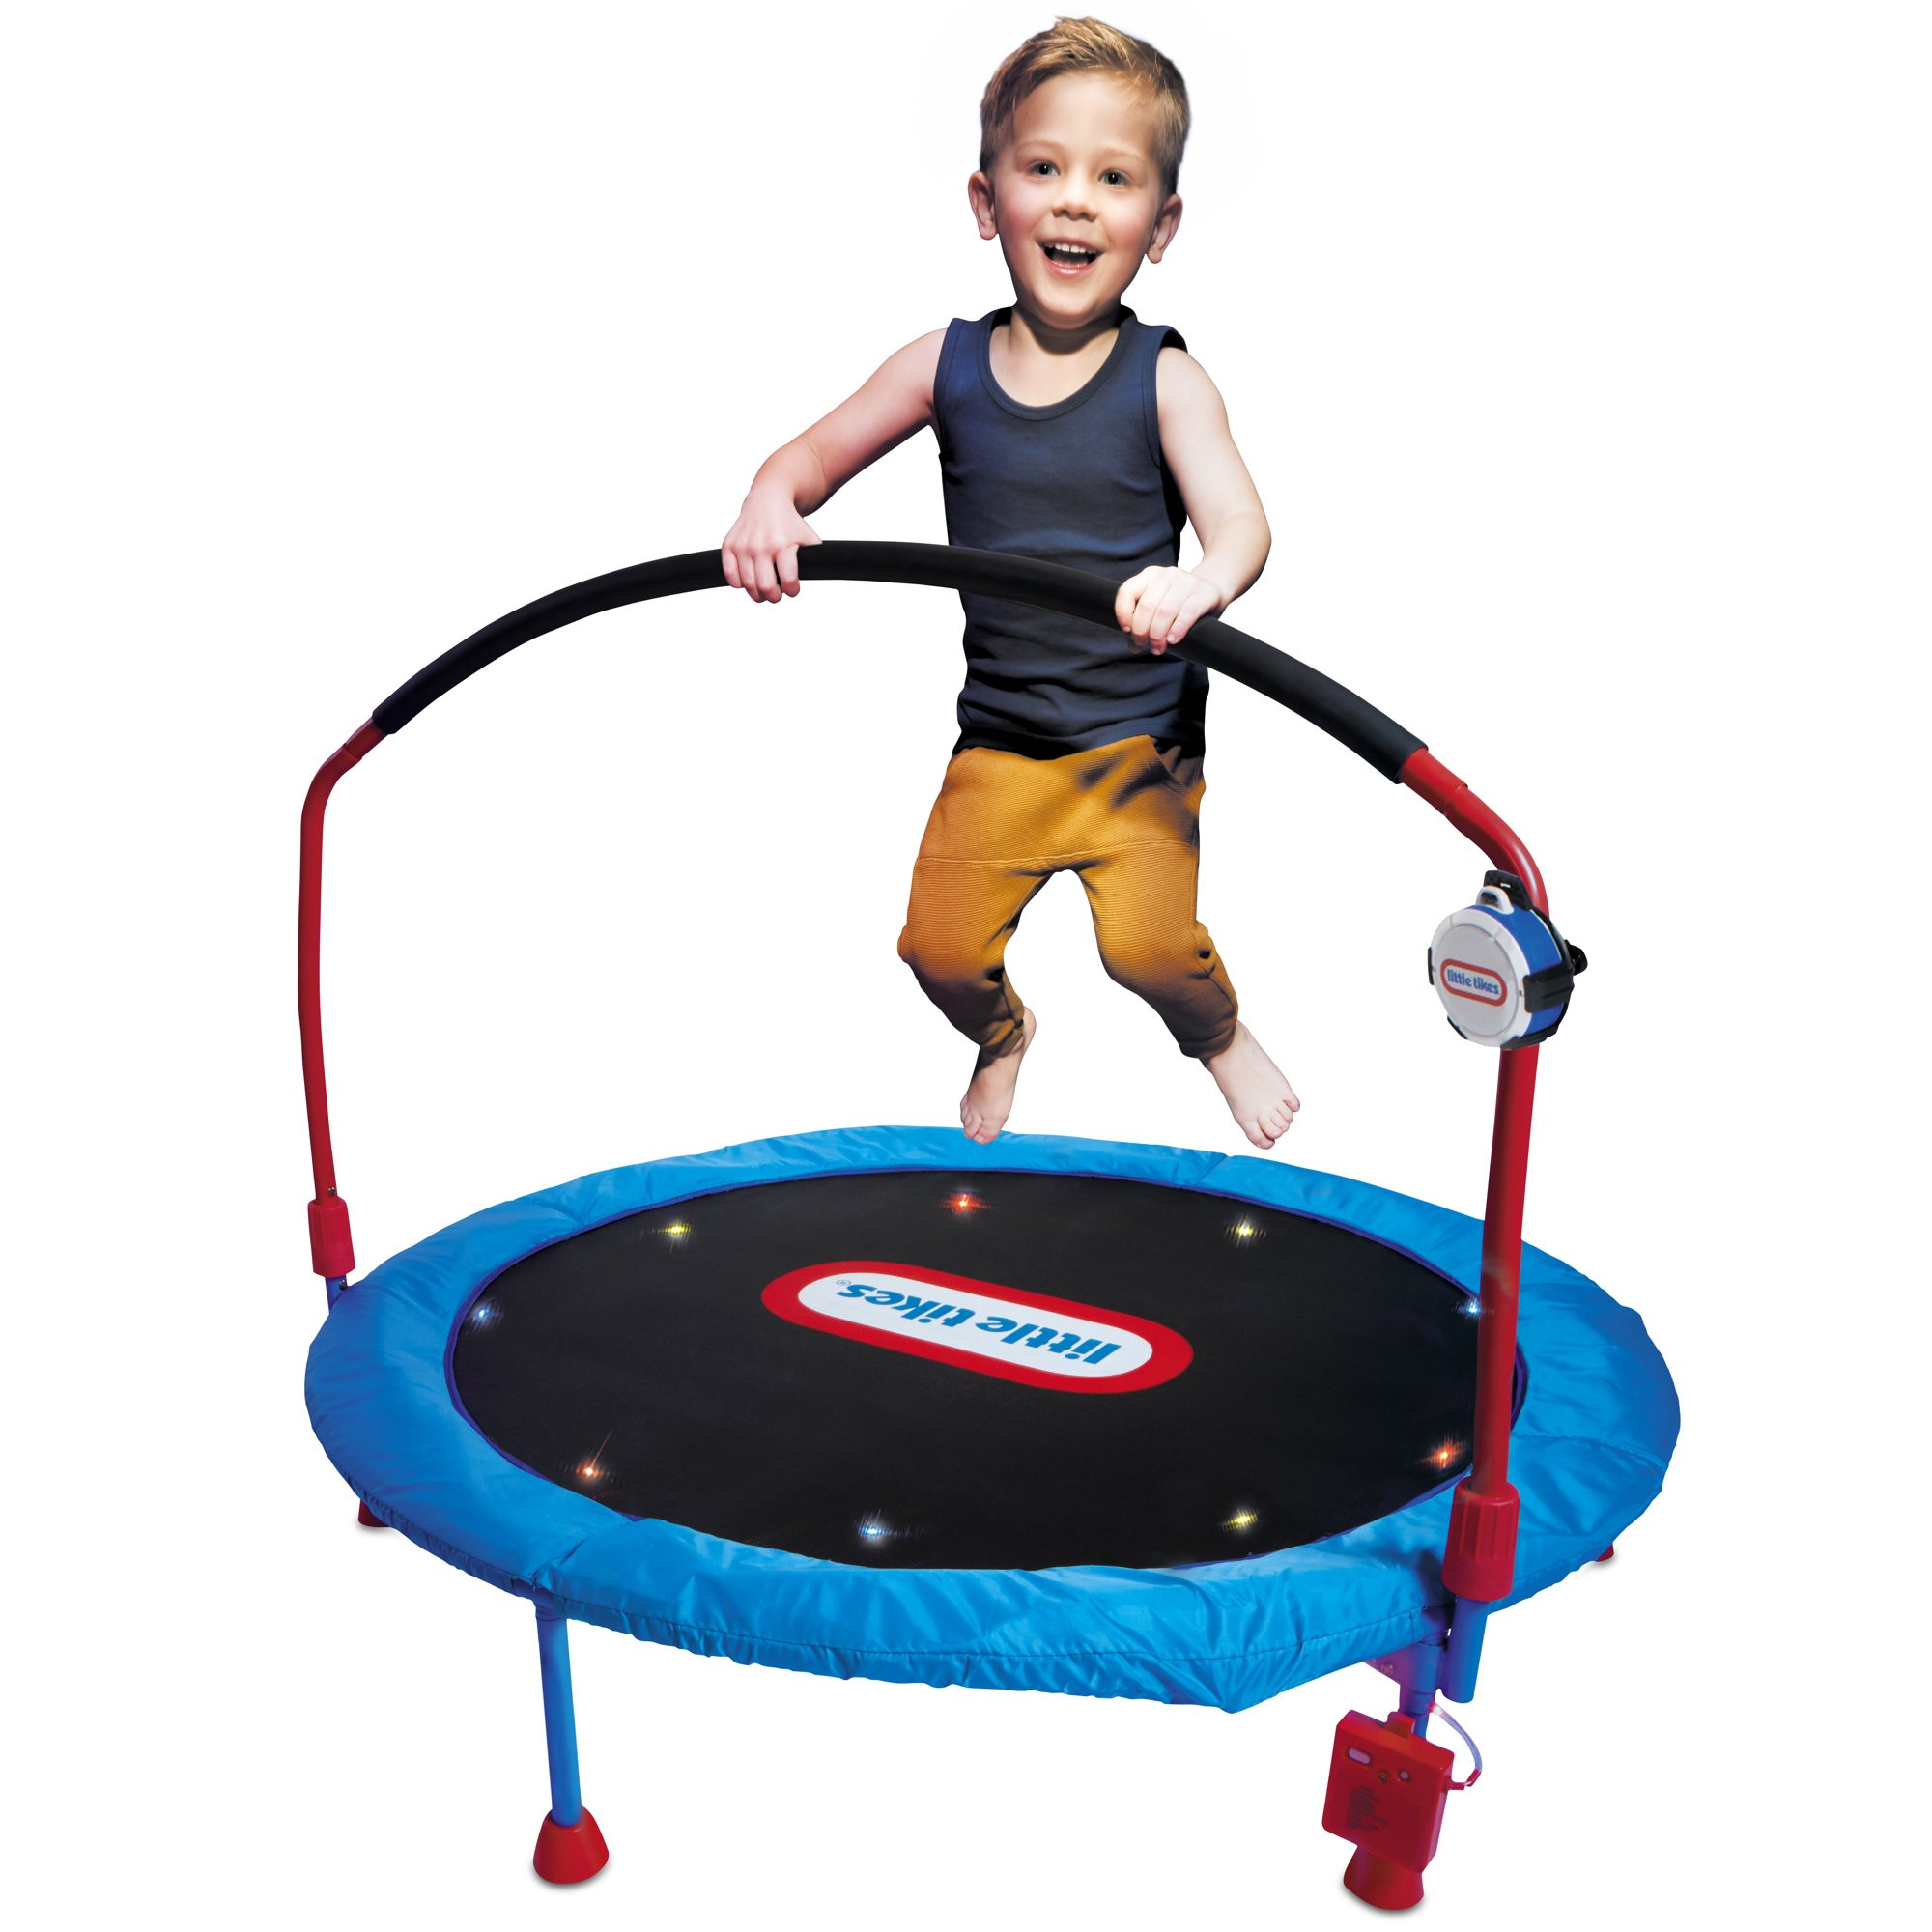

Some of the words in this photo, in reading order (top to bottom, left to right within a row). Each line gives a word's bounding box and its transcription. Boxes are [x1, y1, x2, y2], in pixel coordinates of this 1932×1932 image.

[1447, 968, 1471, 986] little
[1473, 977, 1499, 994] tikes
[837, 1283, 976, 1328] tikes
[975, 1316, 1122, 1364] little
